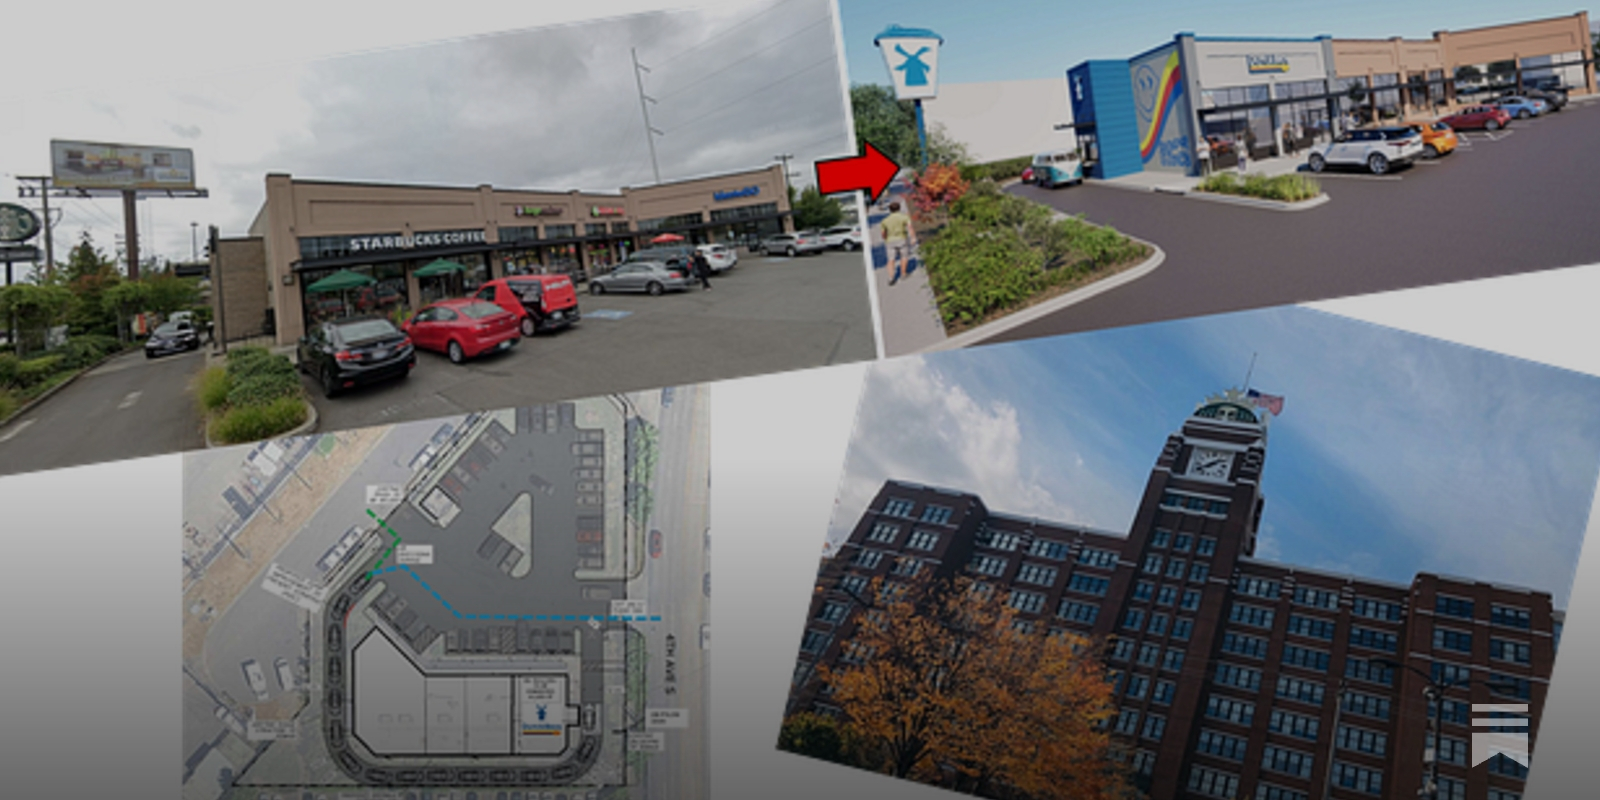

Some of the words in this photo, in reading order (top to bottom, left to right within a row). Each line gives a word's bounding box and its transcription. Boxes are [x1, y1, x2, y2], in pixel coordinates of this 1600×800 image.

[350, 233, 441, 250] STARBUCKS
[665, 633, 676, 657] 4TH
[665, 659, 676, 682] AVE
[664, 685, 677, 695] S
